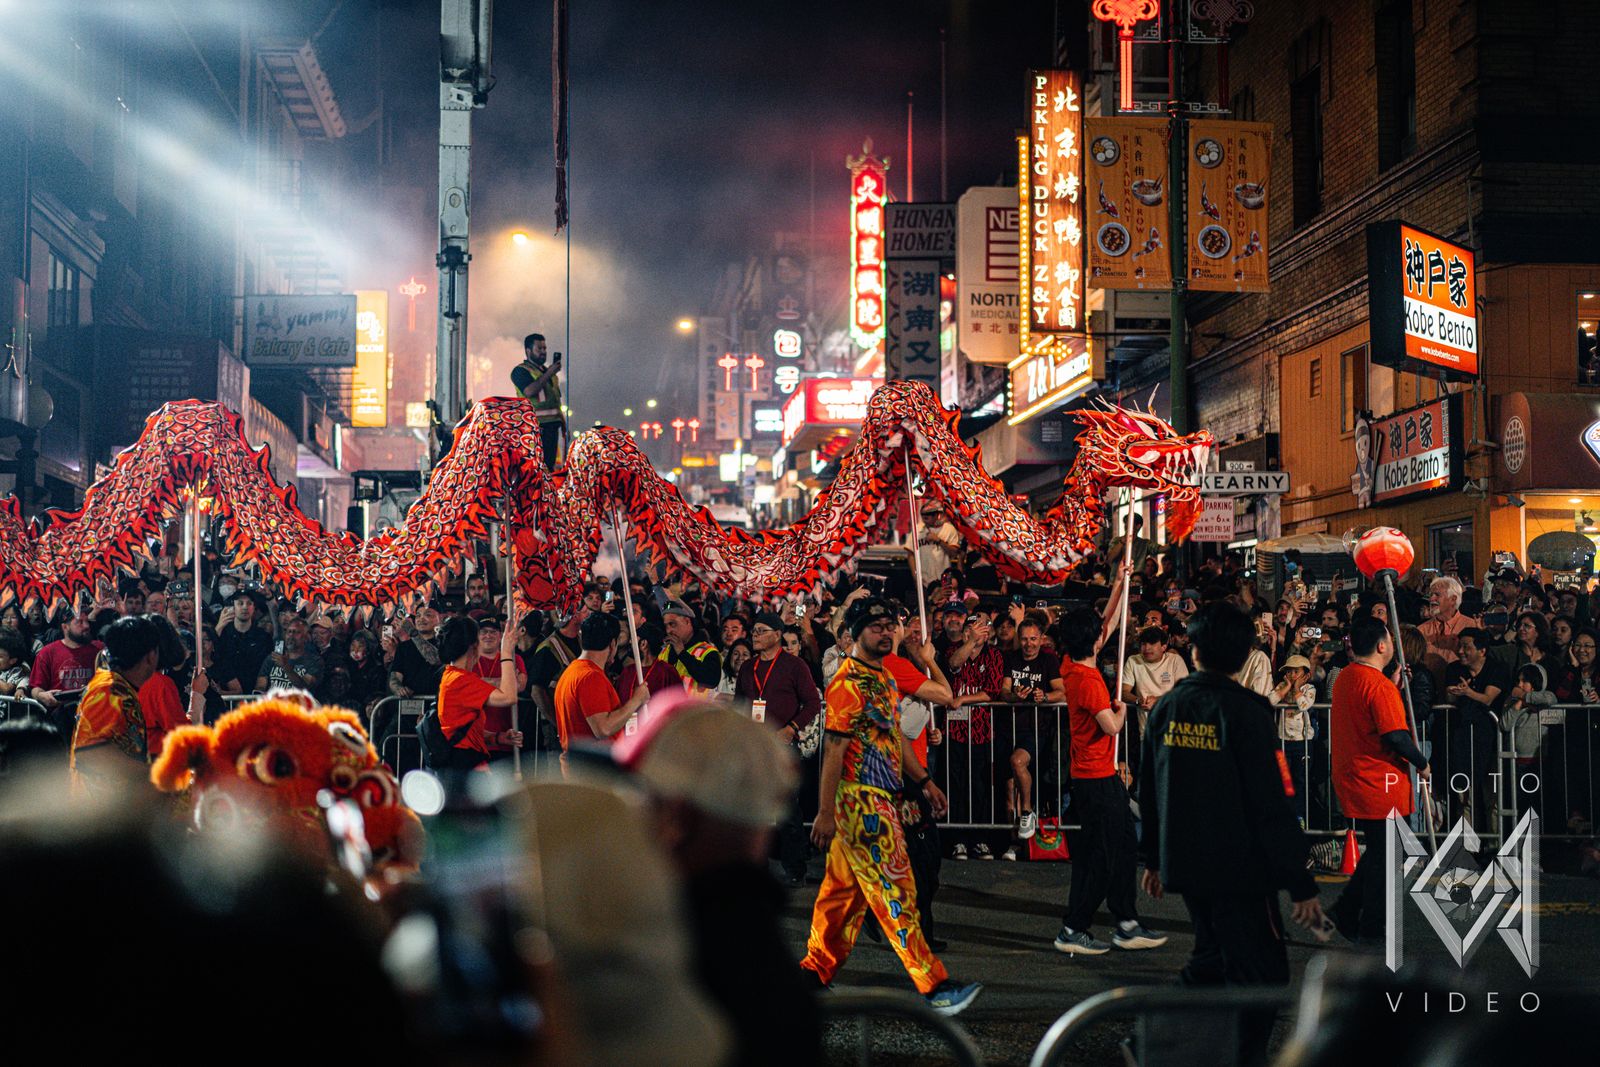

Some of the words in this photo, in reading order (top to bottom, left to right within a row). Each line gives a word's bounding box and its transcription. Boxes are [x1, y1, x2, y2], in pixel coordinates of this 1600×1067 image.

[1034, 76, 1049, 176] PEKING
[1122, 135, 1132, 223] RESTAURANT
[1225, 138, 1234, 225] RESTAURANT
[1034, 185, 1049, 252] DUCK
[1136, 208, 1145, 235] ROW
[1237, 211, 1246, 238] ROW
[970, 310, 1020, 319] MEDICAL
[1404, 300, 1434, 338] Kobe
[1438, 311, 1474, 349] Bento
[252, 336, 303, 361] Bakery
[303, 337, 316, 357] &
[1229, 462, 1244, 471] 900
[1384, 461, 1408, 491] Kobe
[1410, 452, 1440, 484] Bento
[1205, 501, 1233, 511] PARKING
[1553, 574, 1569, 583] Fruit
[1163, 733, 1221, 751] MARSHAL
[1168, 720, 1216, 738] PARADE
